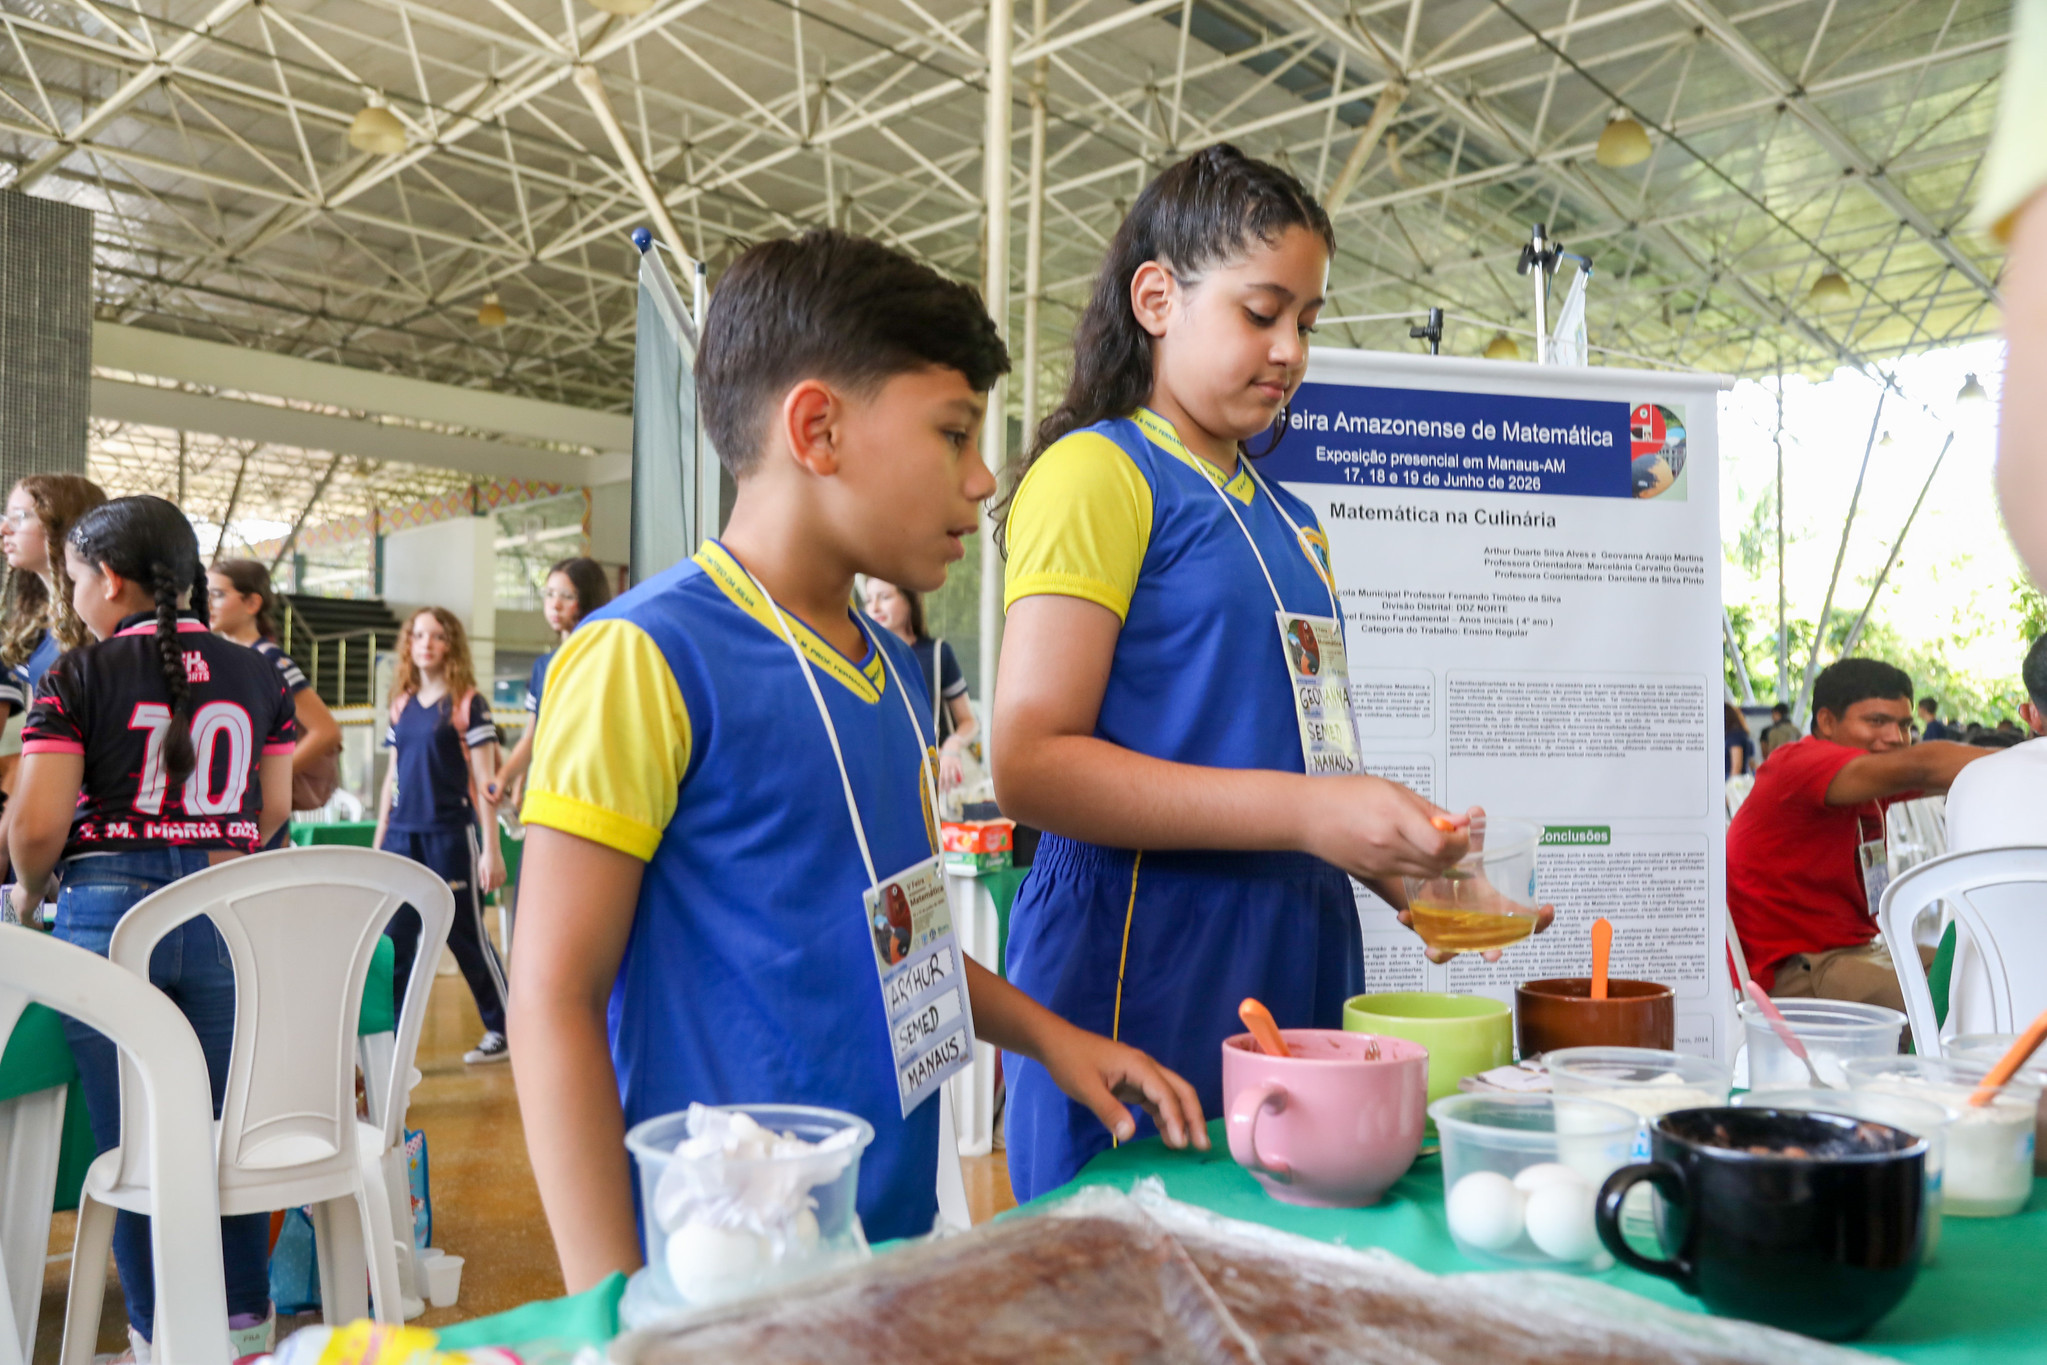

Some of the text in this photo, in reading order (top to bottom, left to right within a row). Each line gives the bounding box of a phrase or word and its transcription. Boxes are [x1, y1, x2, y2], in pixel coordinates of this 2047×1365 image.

[1334, 410, 1466, 440] Amazonense
[1471, 418, 1497, 440] de
[1502, 420, 1614, 447] Matemática
[1316, 445, 1566, 474] Exposição presencial em Manaus-AM
[1343, 467, 1541, 491] 17, 18 e 19 de Junho de 2026
[1330, 502, 1556, 528] Matemática na Culinária
[1484, 546, 1511, 556] Arthur
[1513, 548, 1541, 557] Duarte
[1543, 548, 1565, 558] Silva
[1566, 549, 1590, 559] Alves
[1600, 551, 1643, 561] Geovanna
[1645, 551, 1672, 563] Araújo
[1674, 553, 1704, 563] Martins
[1484, 558, 1531, 569] Professora
[1533, 560, 1584, 571] Orientadora:
[1634, 563, 1671, 573] Carvalho
[1495, 570, 1541, 580] Professora
[1543, 572, 1604, 583] Coorientadora:
[1649, 576, 1660, 585] da
[1661, 576, 1681, 585] Silva
[1683, 577, 1704, 586] Pinto
[1337, 588, 1562, 604] cola Municipal Professor Fernando Timóteo da Silva
[1381, 601, 1508, 614] Divisão Distrital: DDZ NORTE
[1343, 613, 1357, 622] vel
[1359, 613, 1390, 623] Ensino
[1392, 613, 1450, 624] Fundamental
[1459, 616, 1481, 625] Anos
[1483, 616, 1514, 626] iniciais
[1532, 619, 1548, 627] ano
[1361, 625, 1529, 639] Categoria do Trabalho: Ensino Regular
[1307, 723, 1342, 745] SEMED
[128, 701, 252, 816] 10
[1313, 753, 1354, 773] MANAUS
[891, 953, 944, 1012] ARTHUR
[900, 1006, 939, 1052] SEMED
[907, 1036, 960, 1092] MANAUS
